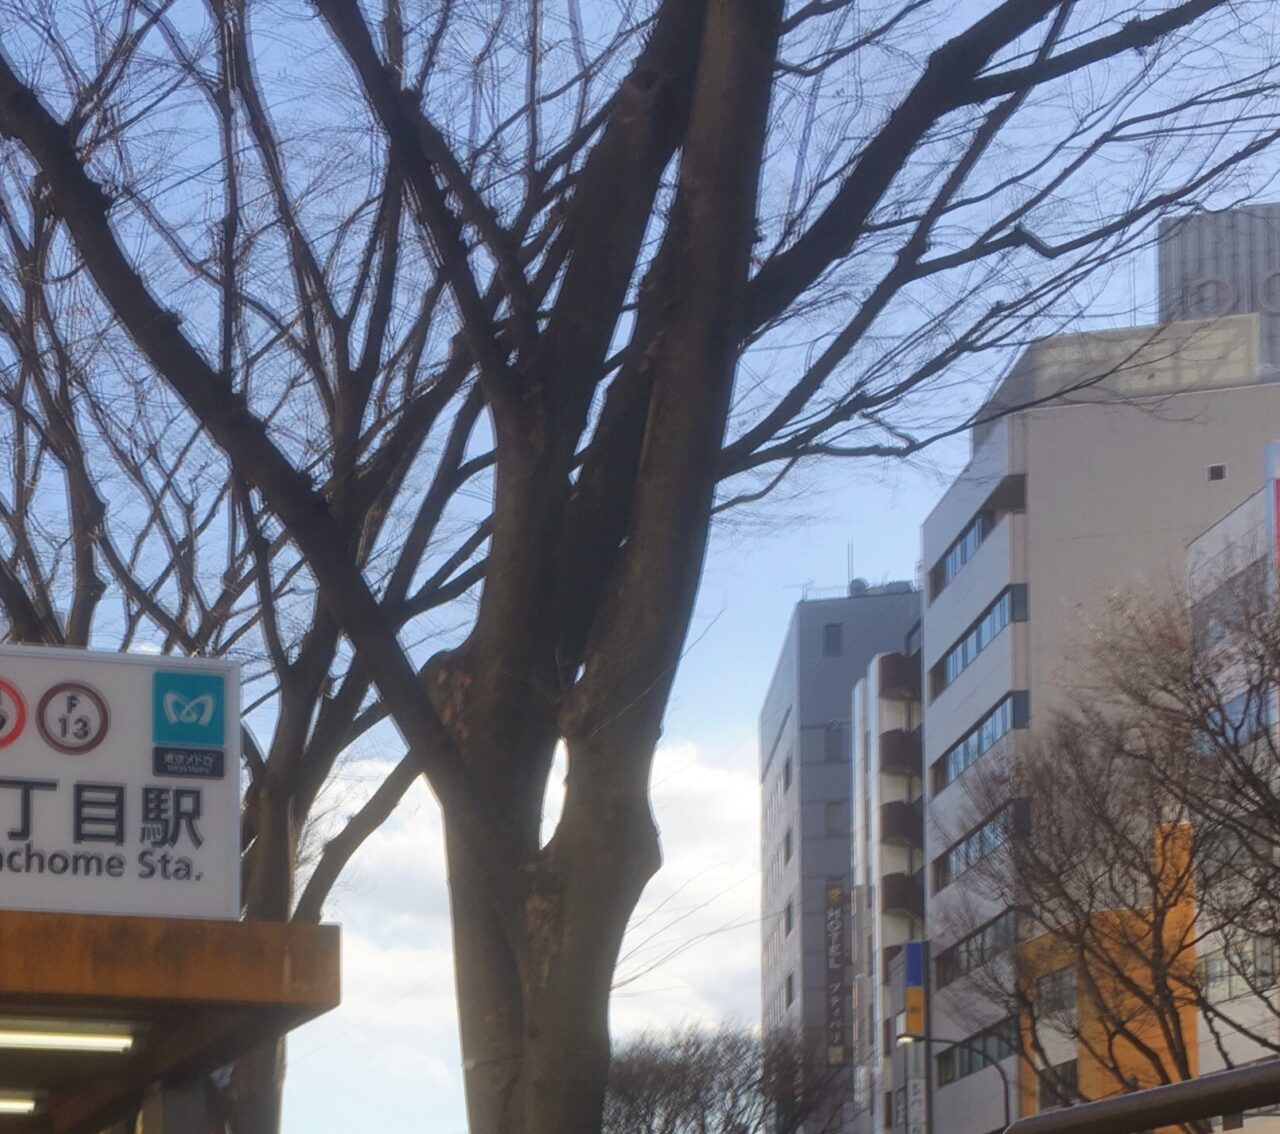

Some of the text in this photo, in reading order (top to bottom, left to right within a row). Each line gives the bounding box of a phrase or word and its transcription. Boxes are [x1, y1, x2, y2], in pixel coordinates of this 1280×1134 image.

[66, 696, 79, 714] F
[58, 714, 91, 740] 13
[137, 850, 204, 881] Sta.
